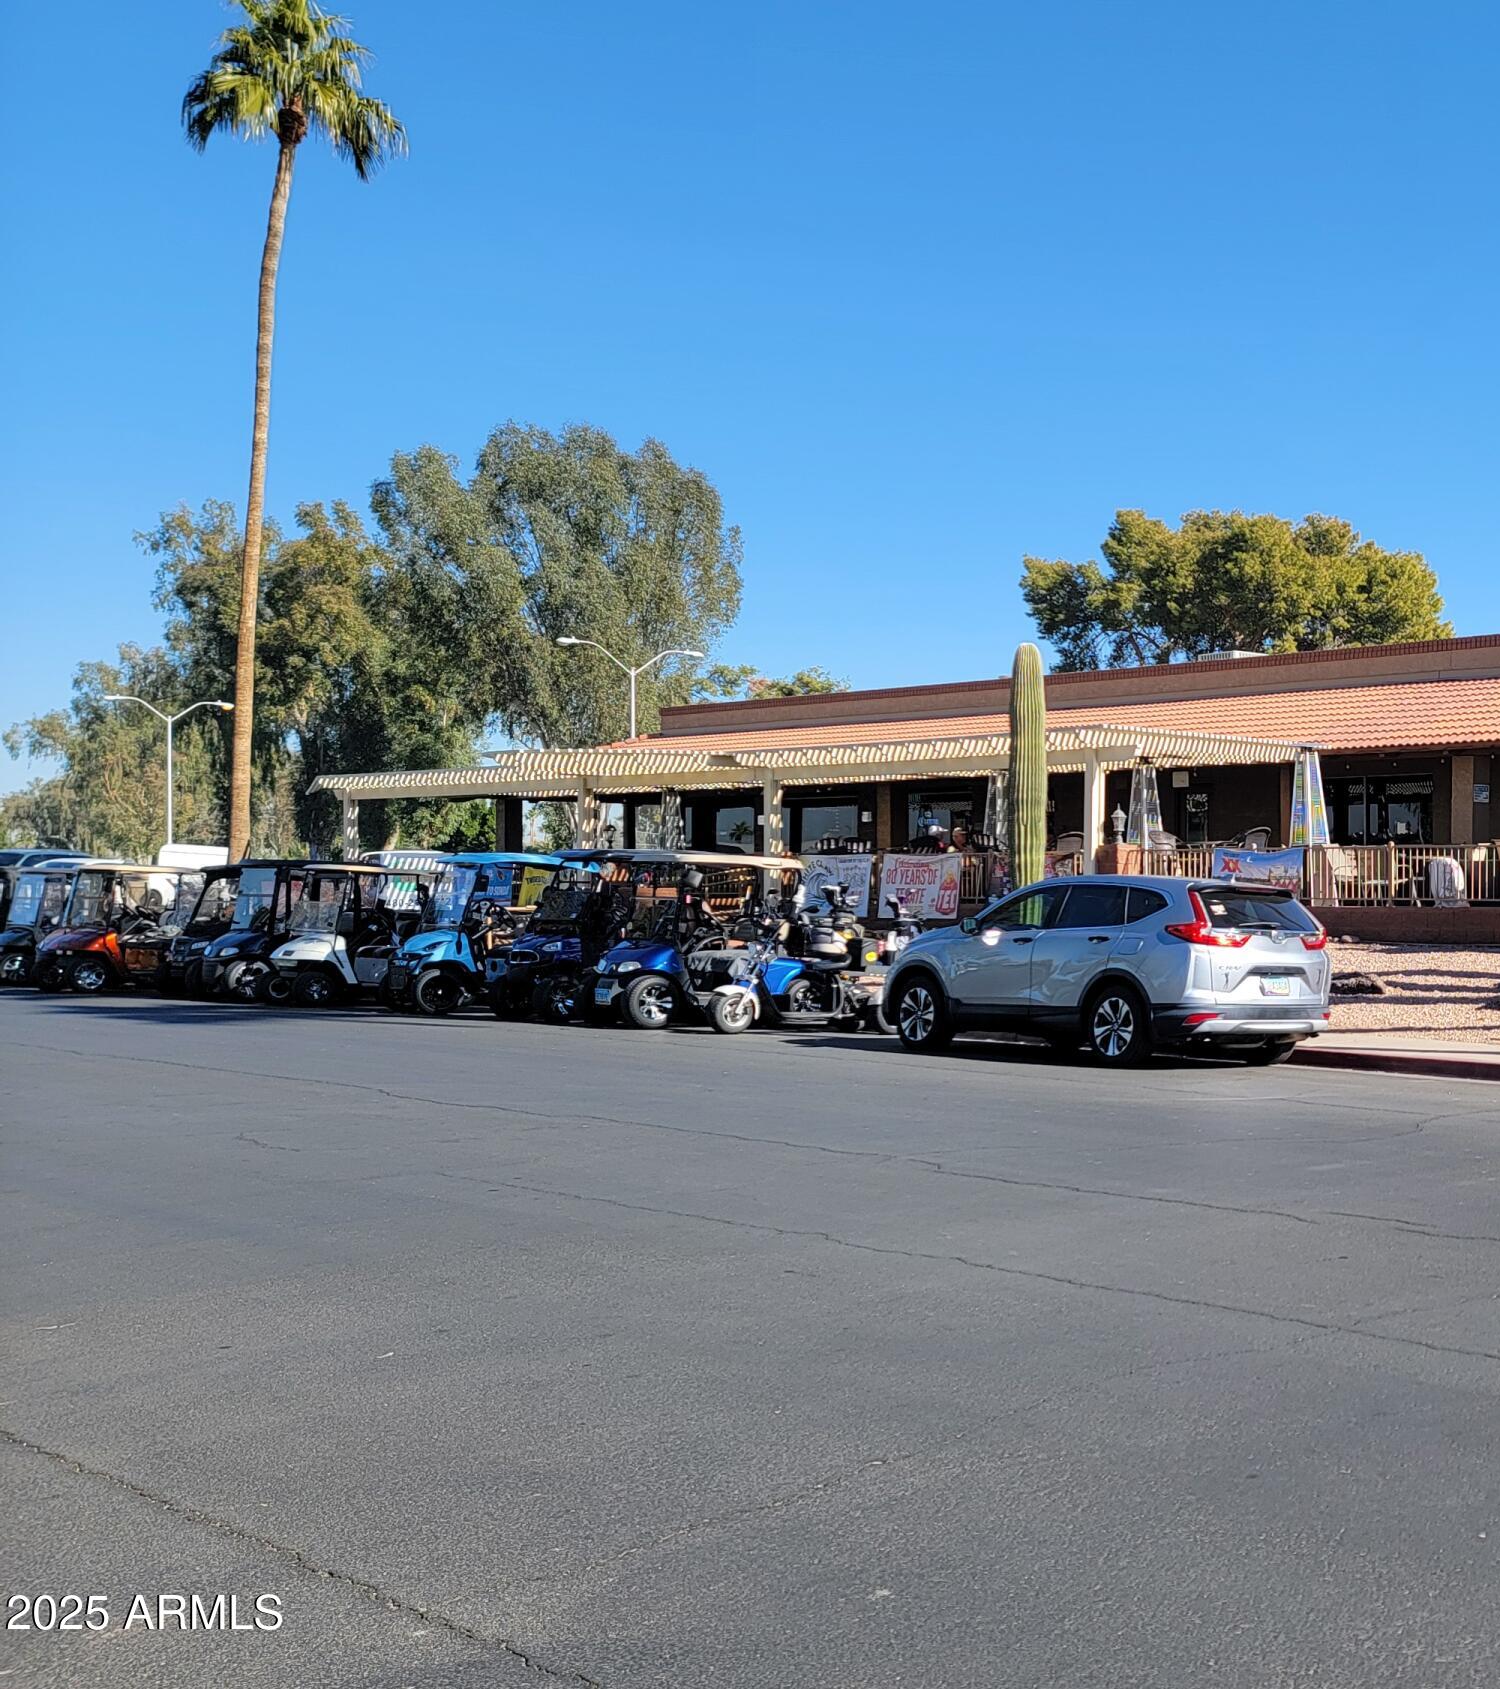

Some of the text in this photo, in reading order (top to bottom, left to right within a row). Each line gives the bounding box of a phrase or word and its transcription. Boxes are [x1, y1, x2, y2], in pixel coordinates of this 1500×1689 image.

[886, 869, 939, 886] 80 YEARS OF
